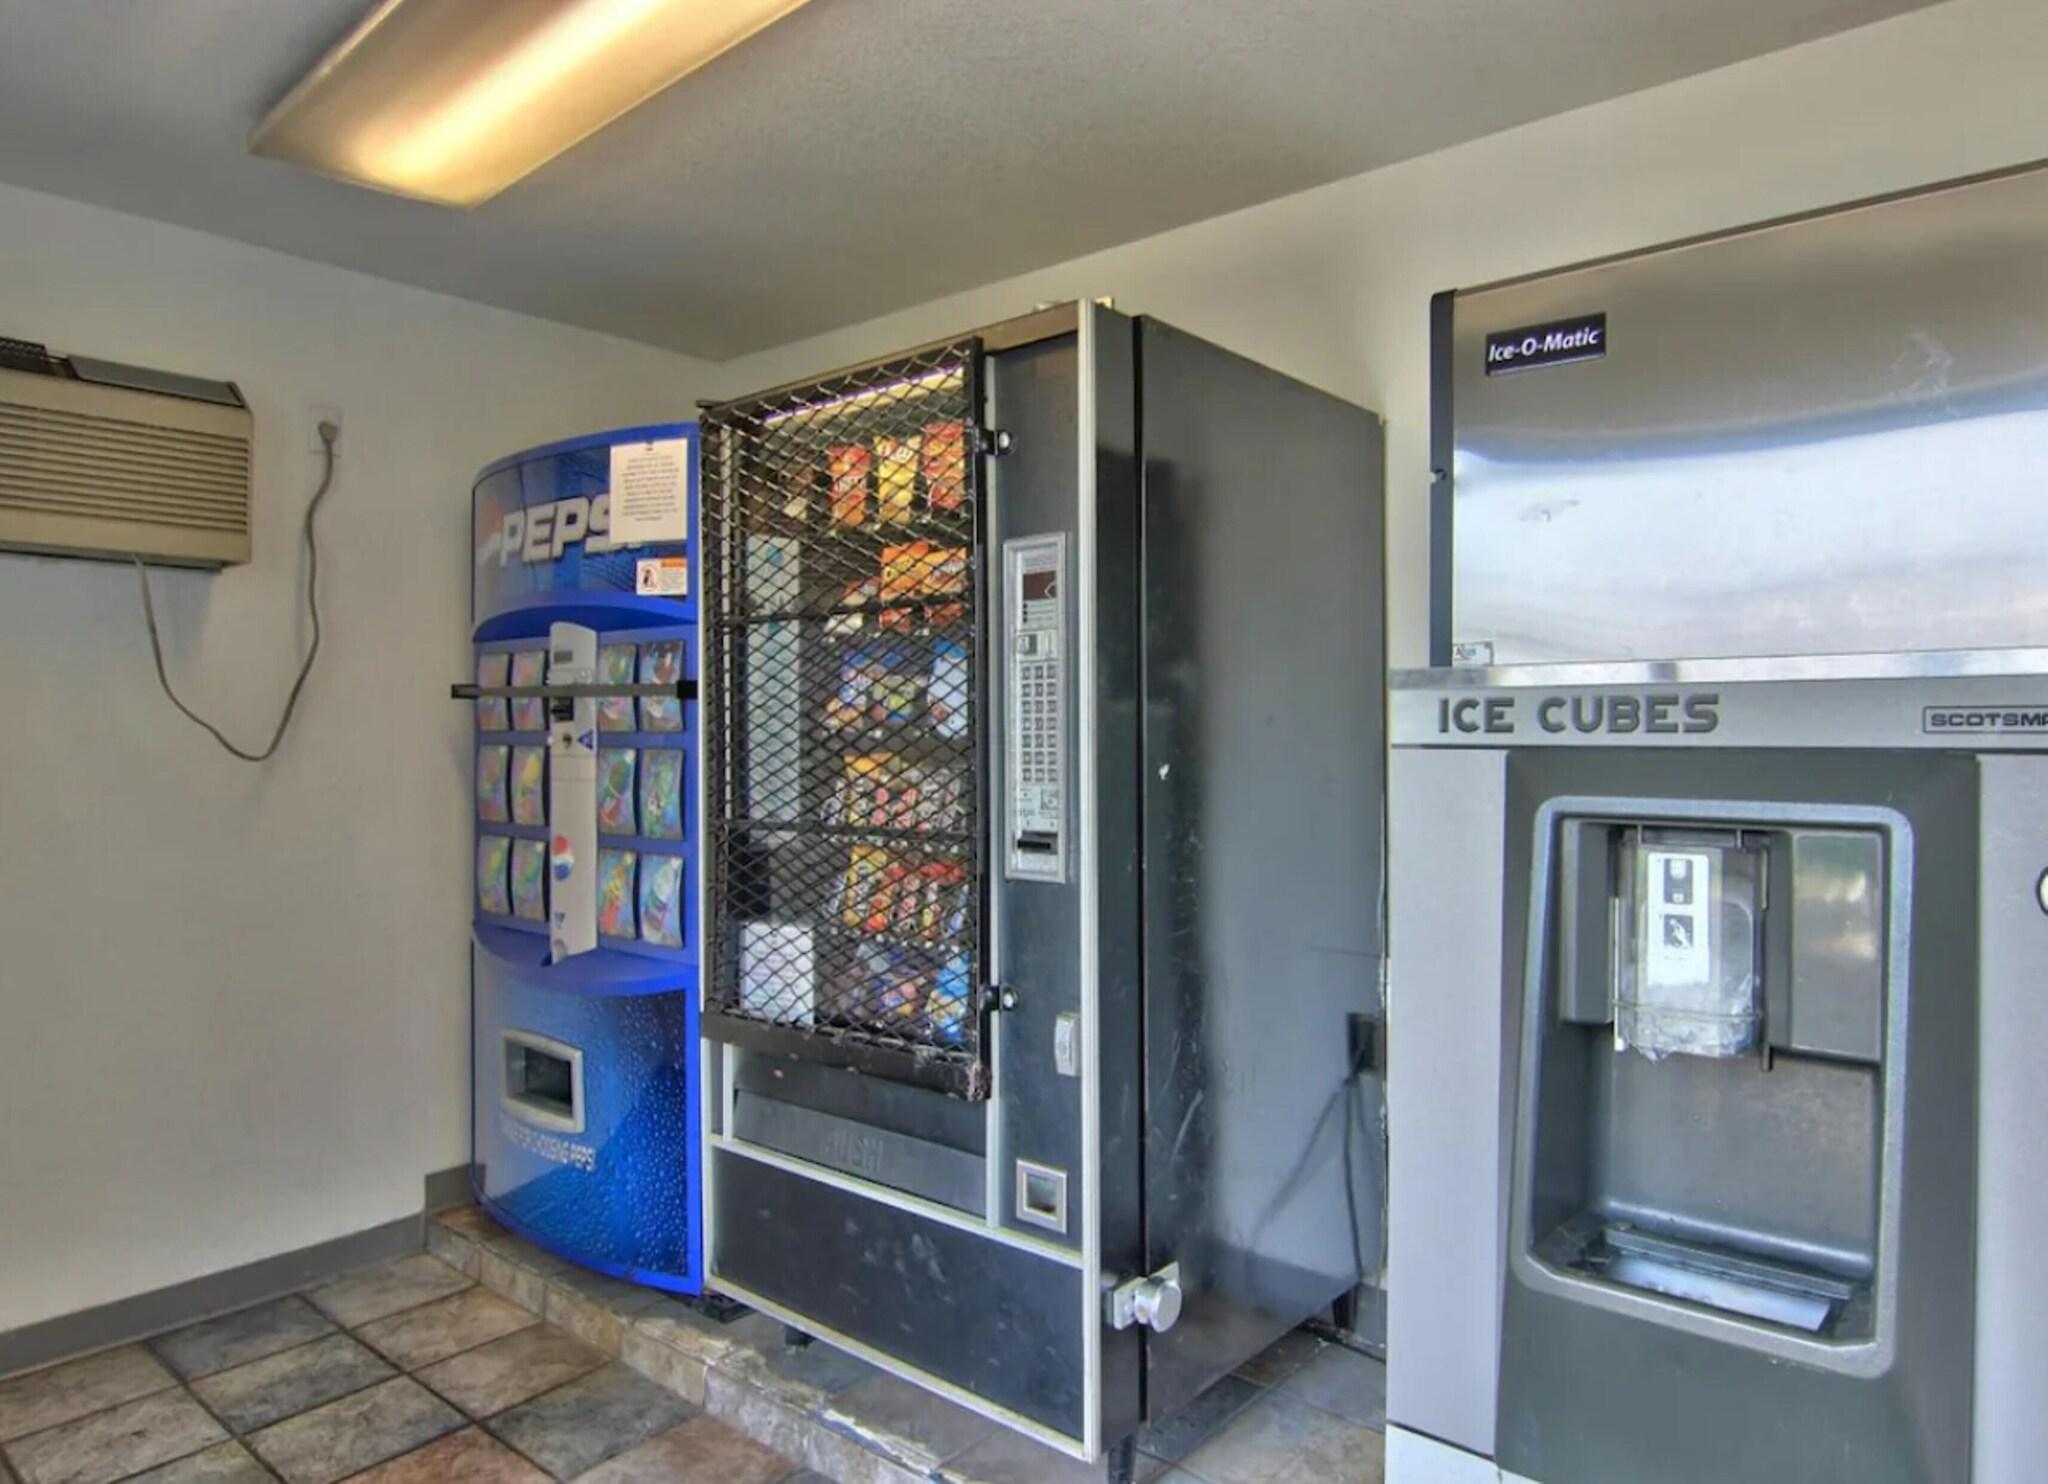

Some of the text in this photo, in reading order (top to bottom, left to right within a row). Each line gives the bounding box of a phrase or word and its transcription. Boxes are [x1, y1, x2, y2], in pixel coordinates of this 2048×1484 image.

[1488, 327, 1601, 362] Ice-O-Matic
[1438, 693, 1719, 734] ICE CUBES
